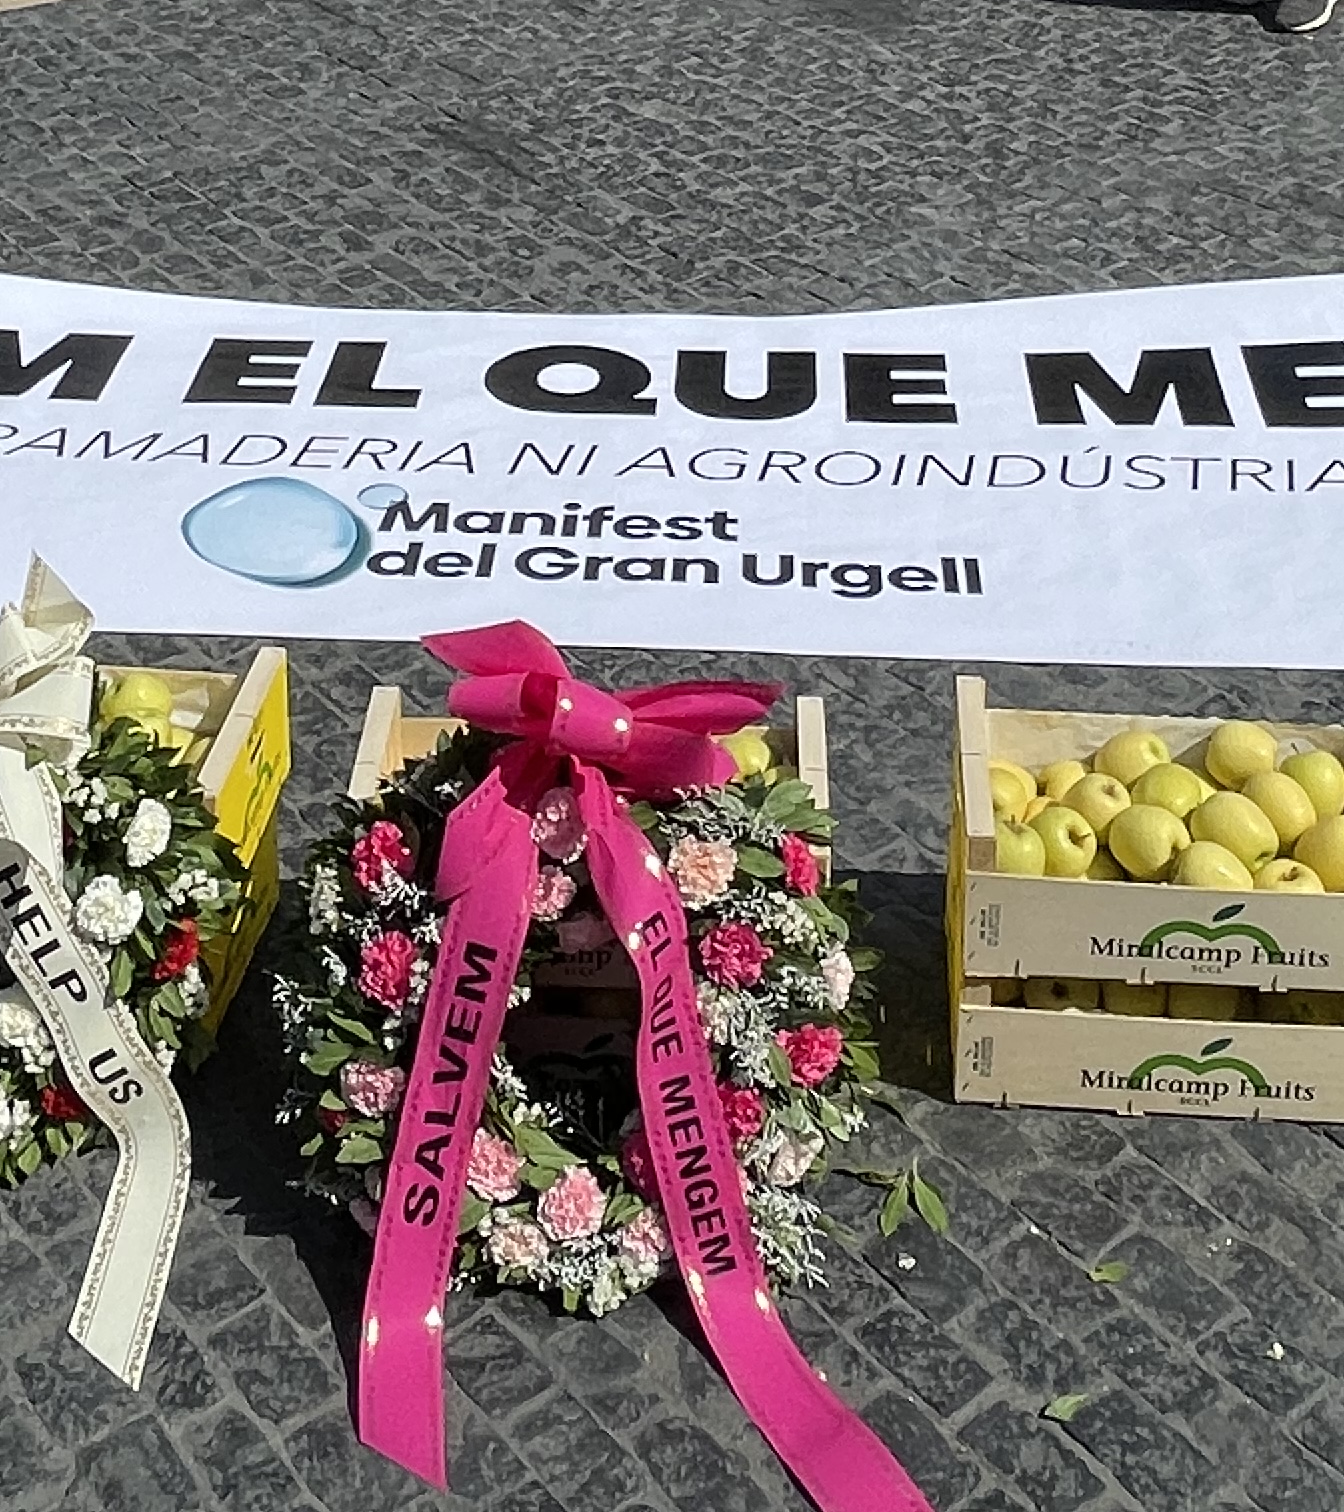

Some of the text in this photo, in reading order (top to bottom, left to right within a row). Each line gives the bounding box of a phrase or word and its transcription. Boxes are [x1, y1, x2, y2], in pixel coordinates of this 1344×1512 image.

[183, 338, 423, 408] EL
[484, 345, 958, 424] QUE
[508, 442, 599, 477] NI
[376, 500, 739, 542] Manifest
[366, 543, 984, 599] del Gran Urgell
[1089, 936, 1330, 968] Miralcamp Fruits
[88, 1048, 144, 1107] US
[404, 940, 498, 1228] SALVEM
[642, 910, 739, 1278] EL QUE MENGEM
[1080, 1069, 1317, 1102] Miralcamp Fruits
